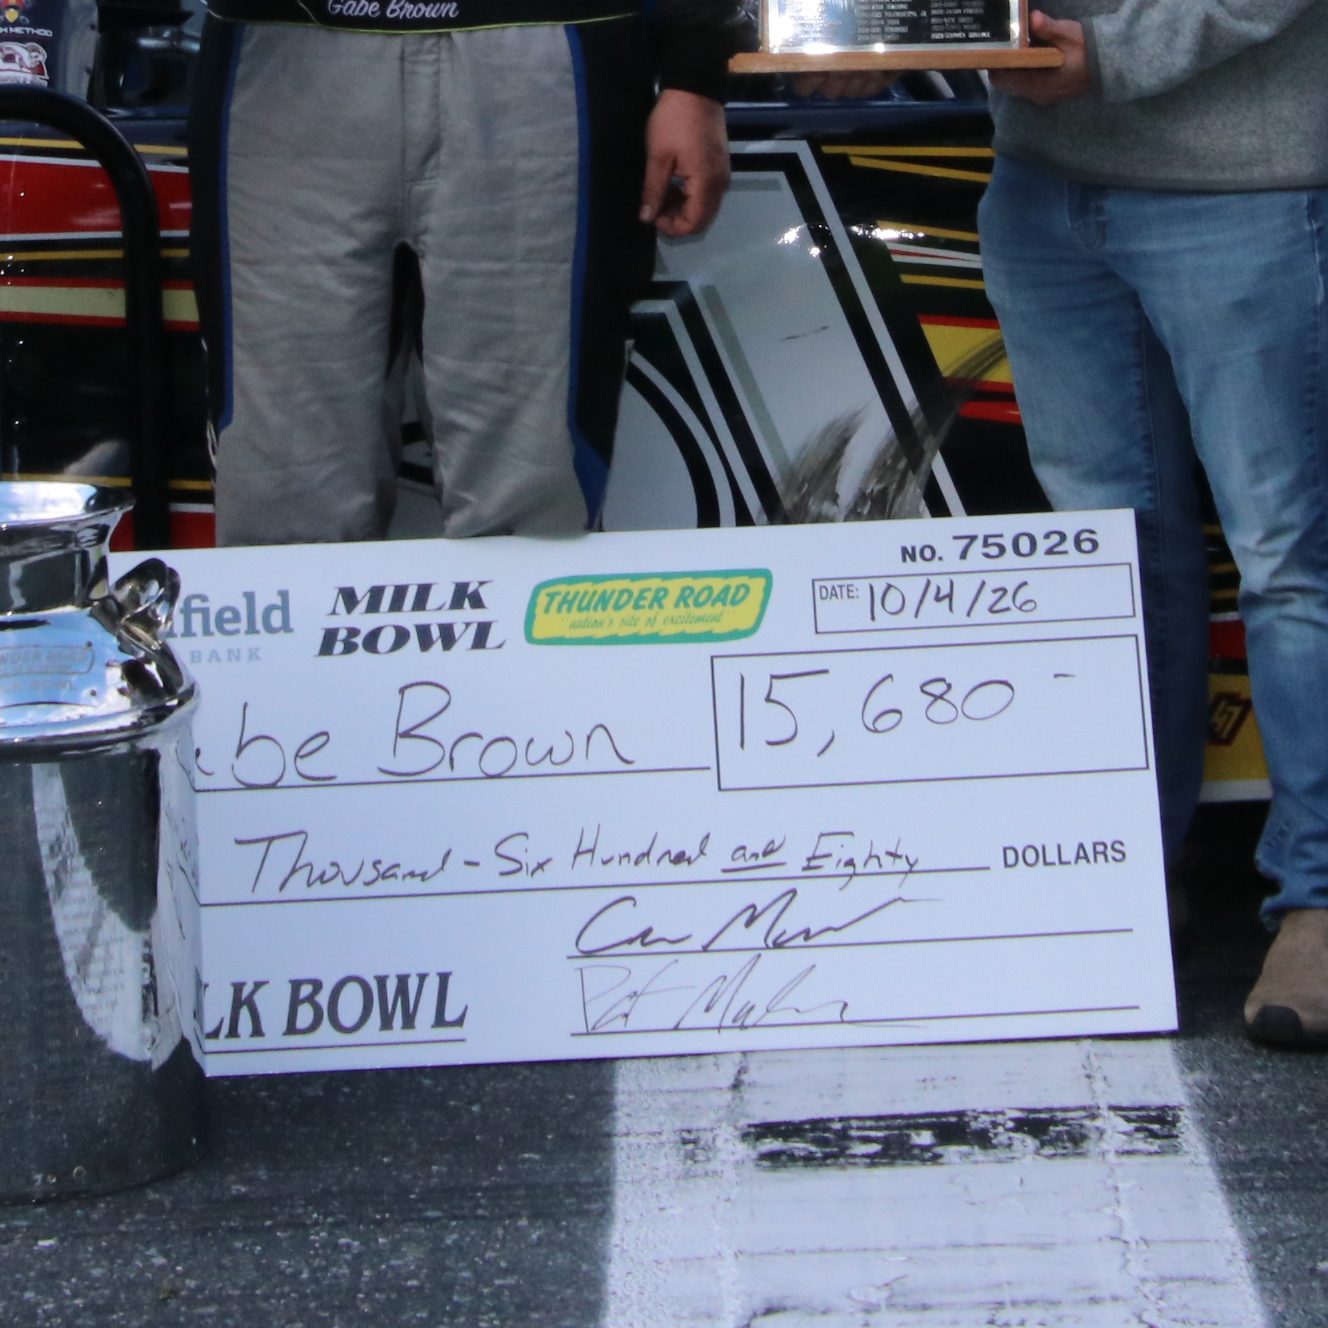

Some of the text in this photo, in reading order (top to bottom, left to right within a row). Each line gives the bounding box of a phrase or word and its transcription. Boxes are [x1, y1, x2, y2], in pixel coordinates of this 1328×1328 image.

[8, 26, 54, 37] METHOD
[900, 528, 1100, 563] NO. 75026
[326, 580, 495, 617] MILK
[543, 583, 752, 615] THUNDER ROAD
[818, 578, 1038, 622] DATE: 10/4/26
[189, 647, 262, 665] BANK
[313, 620, 507, 658] BOWL
[377, 680, 635, 779] Brown
[493, 831, 554, 878] Six
[572, 822, 711, 872] Hundred
[802, 831, 920, 891] Eighty
[1001, 839, 1127, 870] DOLLARS
[282, 971, 469, 1036] BOWL
